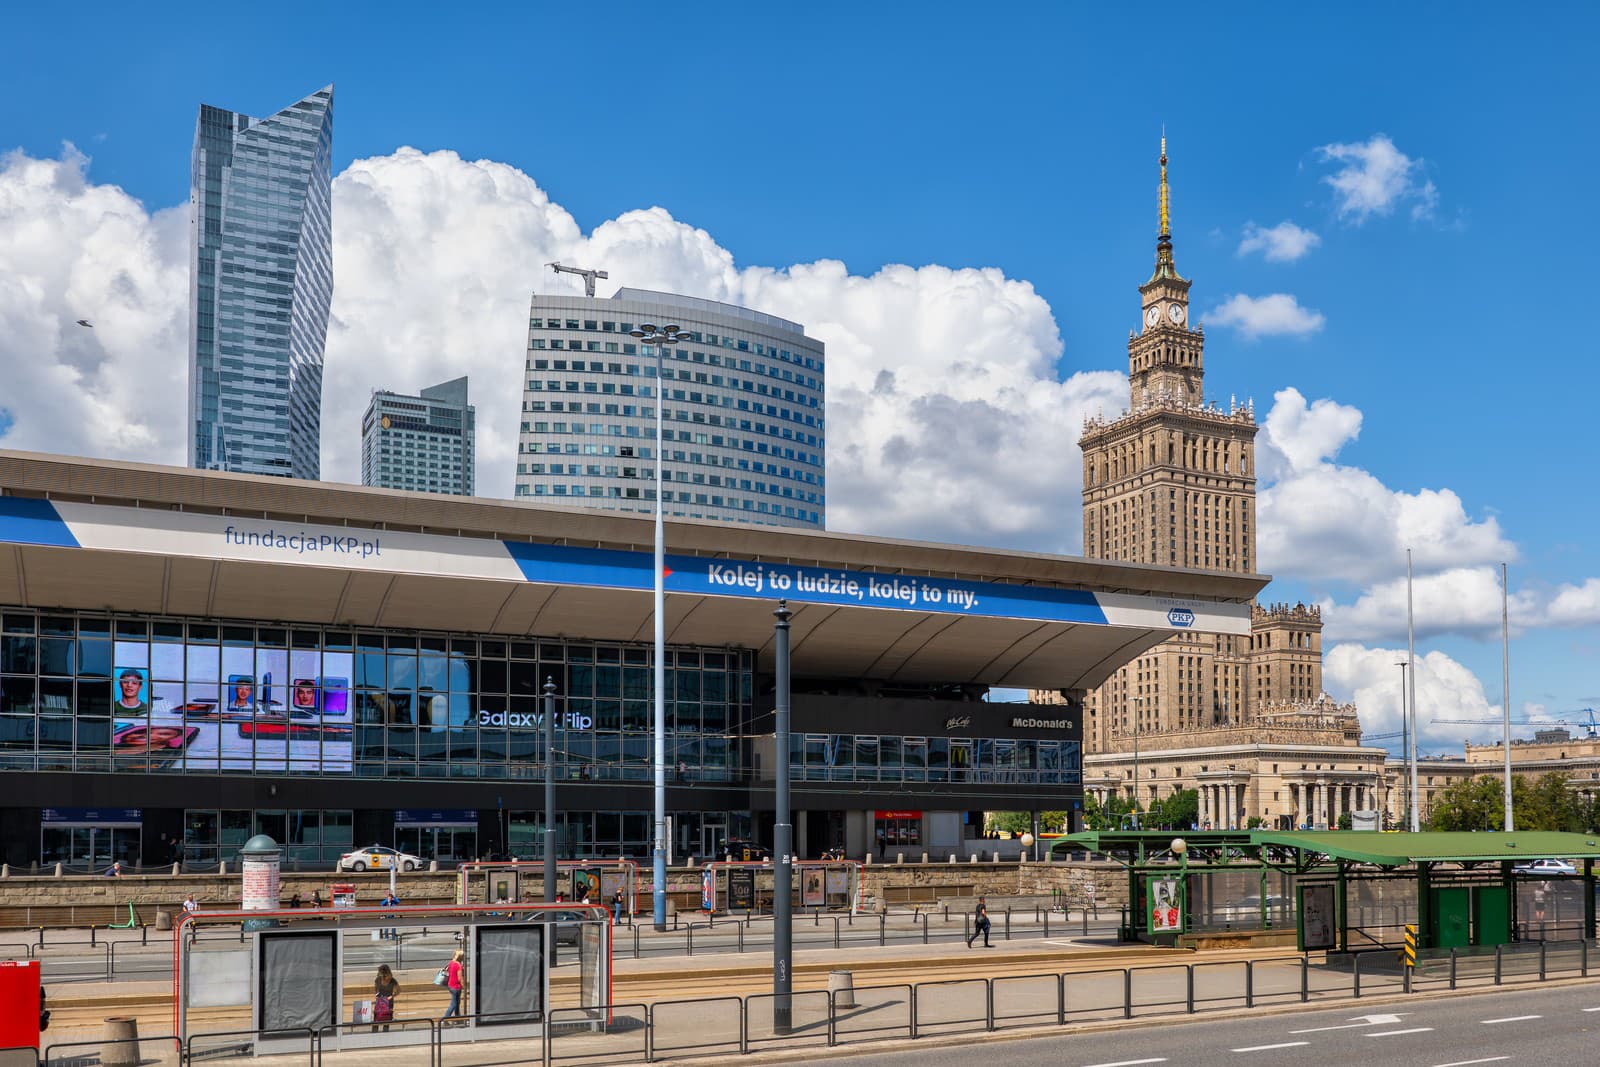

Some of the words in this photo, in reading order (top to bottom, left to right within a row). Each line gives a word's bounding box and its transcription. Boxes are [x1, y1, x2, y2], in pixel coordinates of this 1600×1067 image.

[224, 526, 381, 559] fundacjaPKP.pl
[708, 564, 764, 592] Kolej
[768, 570, 791, 590] to
[796, 571, 864, 600] ludzie,
[869, 577, 917, 604] kolej
[922, 583, 942, 603] to
[947, 588, 979, 609] my.
[1171, 613, 1192, 622] PKP
[476, 710, 543, 728] Galaxy
[562, 712, 592, 730] Flip
[1012, 718, 1073, 729] McDonald's
